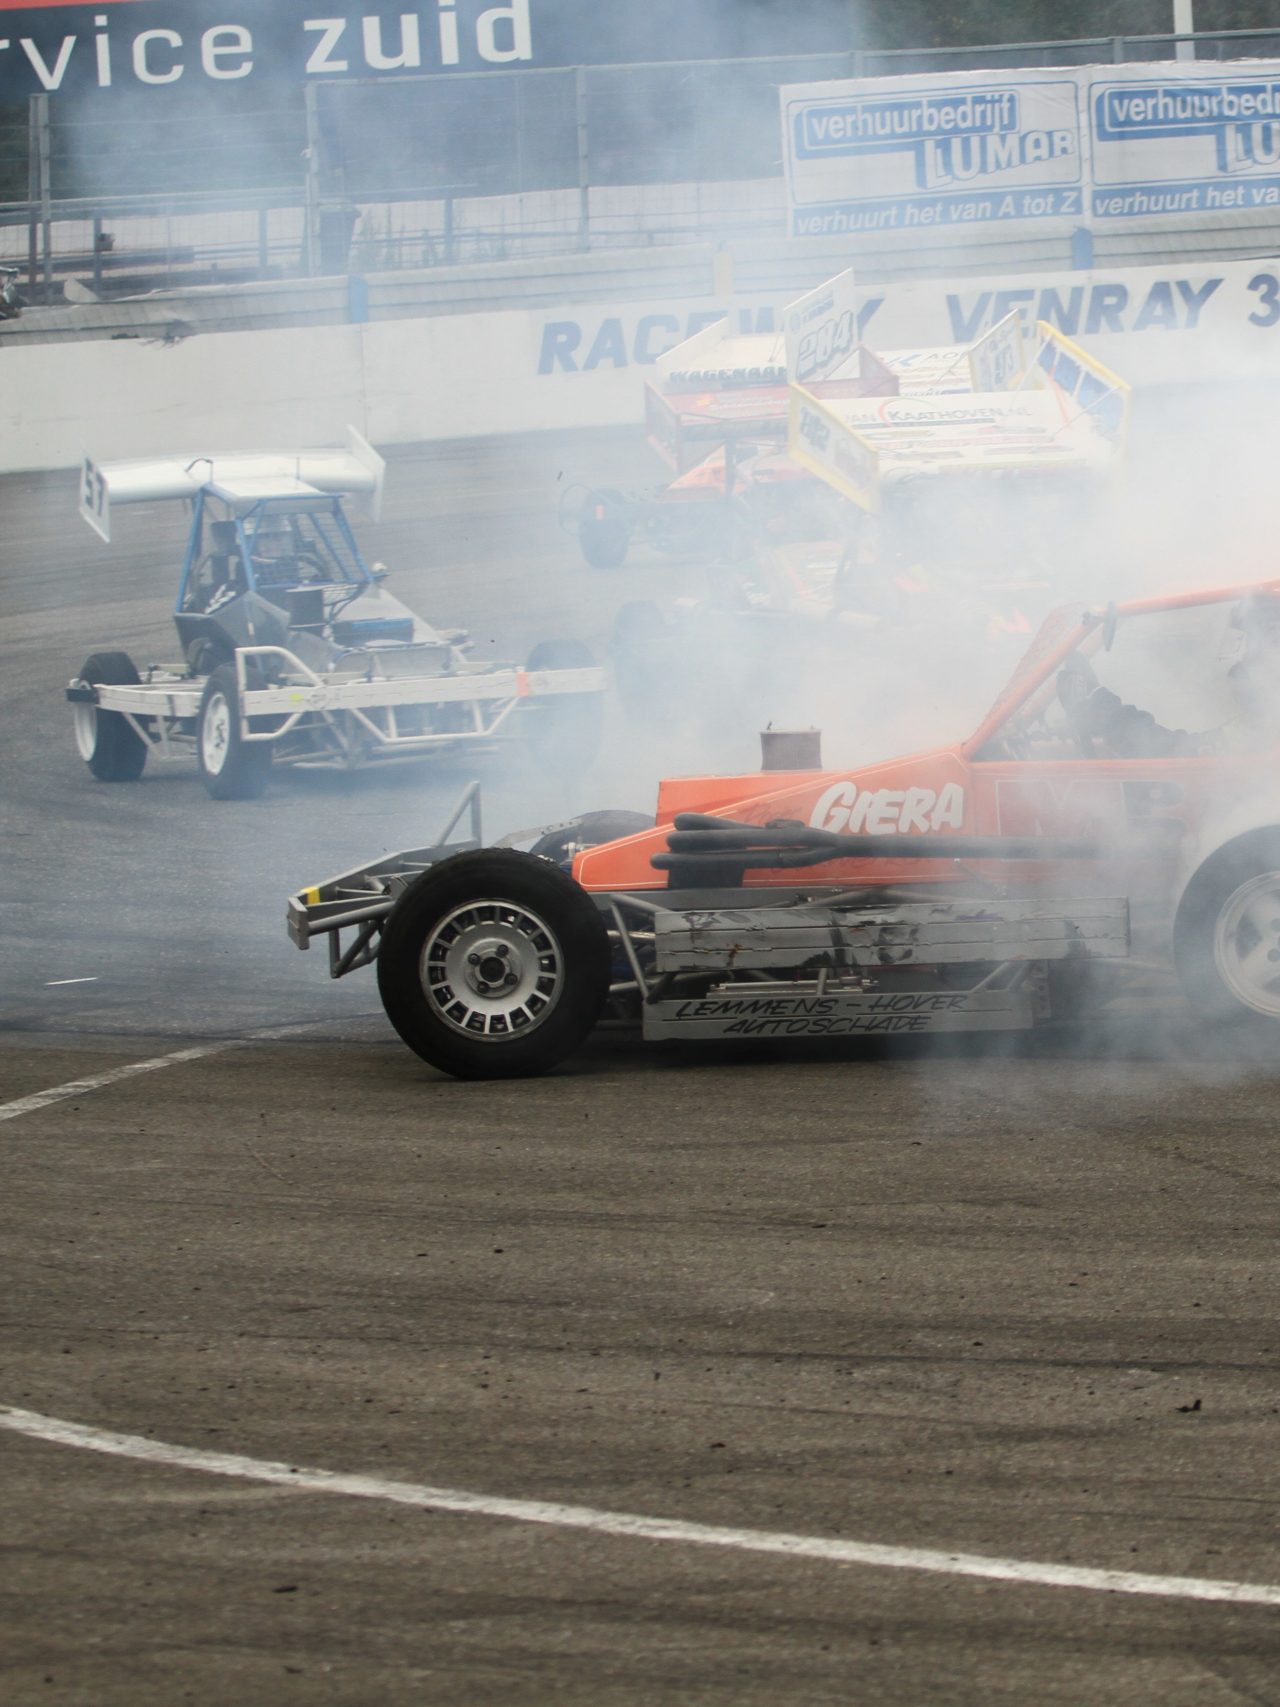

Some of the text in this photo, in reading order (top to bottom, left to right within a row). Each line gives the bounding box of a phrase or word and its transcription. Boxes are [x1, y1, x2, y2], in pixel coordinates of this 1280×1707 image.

[0, 0, 533, 90] vice zuid
[811, 91, 1013, 140] verhuurbedrijf
[918, 128, 1076, 189] LUMAR
[797, 191, 1078, 236] verhuurt het van A tot Z
[1095, 187, 1199, 216] verhuurt
[1206, 183, 1243, 206] het
[946, 277, 1224, 343] VENRAY
[811, 782, 964, 835] GIERA
[676, 997, 840, 1019] LEMMENS
[869, 994, 967, 1013] HOVER
[723, 1015, 932, 1034] AUTOSCHADE
